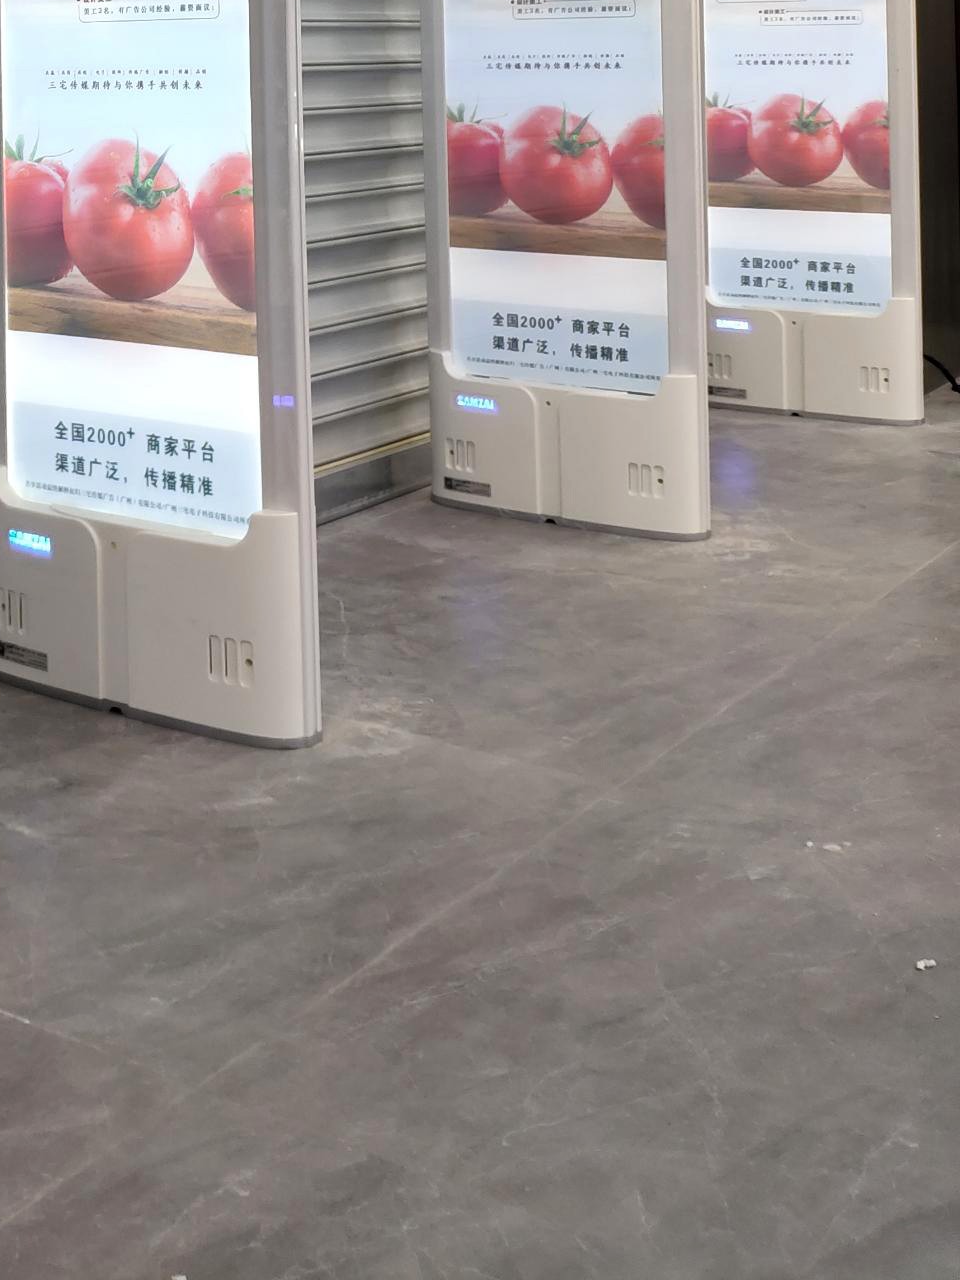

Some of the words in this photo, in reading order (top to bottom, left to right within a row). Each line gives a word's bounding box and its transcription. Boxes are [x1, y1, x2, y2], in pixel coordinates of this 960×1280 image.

[807, 261, 856, 275] 商家平台
[571, 319, 631, 338] 商家平台
[569, 343, 629, 362] 传播精准
[146, 433, 215, 464] 商家平台
[144, 467, 213, 497] 传播精准
